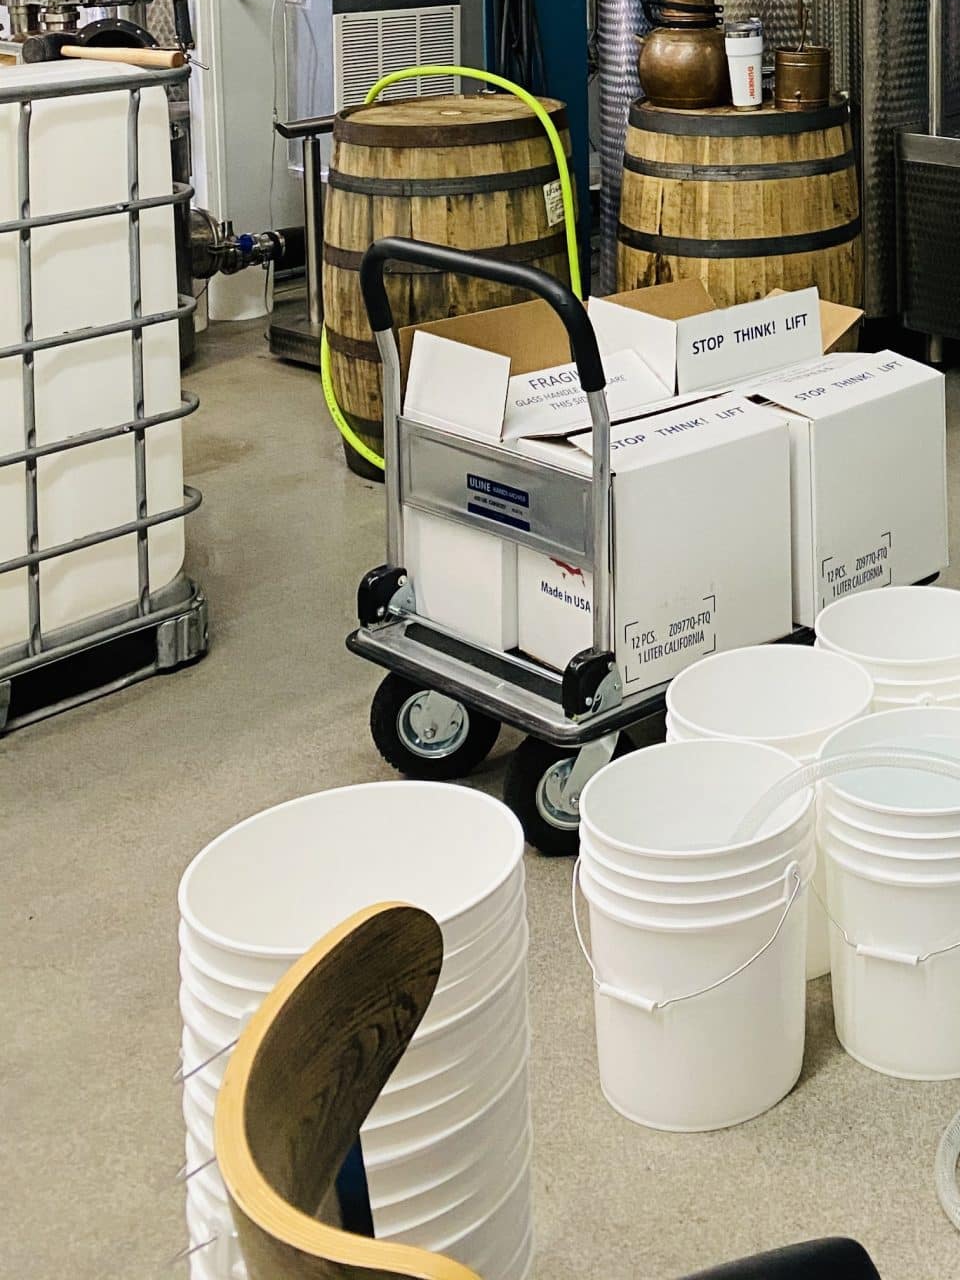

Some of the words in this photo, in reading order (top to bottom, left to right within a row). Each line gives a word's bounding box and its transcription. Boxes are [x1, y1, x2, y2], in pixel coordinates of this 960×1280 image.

[692, 335, 724, 355] STOP
[734, 321, 776, 343] THINK!
[785, 314, 808, 330] LIFT
[528, 370, 580, 390] FRAGI
[794, 387, 826, 401] STOP
[831, 372, 875, 389] THINK!
[878, 360, 903, 373] LIFT
[515, 395, 543, 408] GLASS
[544, 386, 580, 401] HANDLE
[548, 397, 571, 410] THIS
[573, 393, 588, 406] SID
[610, 434, 646, 450] STOP
[654, 417, 709, 436] THINK!
[715, 407, 745, 419] LIFT
[469, 476, 491, 492] ULINE
[827, 570, 834, 583] 12
[836, 578, 852, 596] LITER
[852, 564, 883, 588] CALIFORNIA
[540, 580, 563, 601] Made
[564, 590, 573, 605] in
[573, 594, 592, 613] USA
[631, 636, 640, 650] 12
[641, 630, 657, 646] PCS.
[638, 652, 642, 664] 1
[643, 645, 663, 663] LITER
[664, 630, 705, 656] CALIFORNIA
